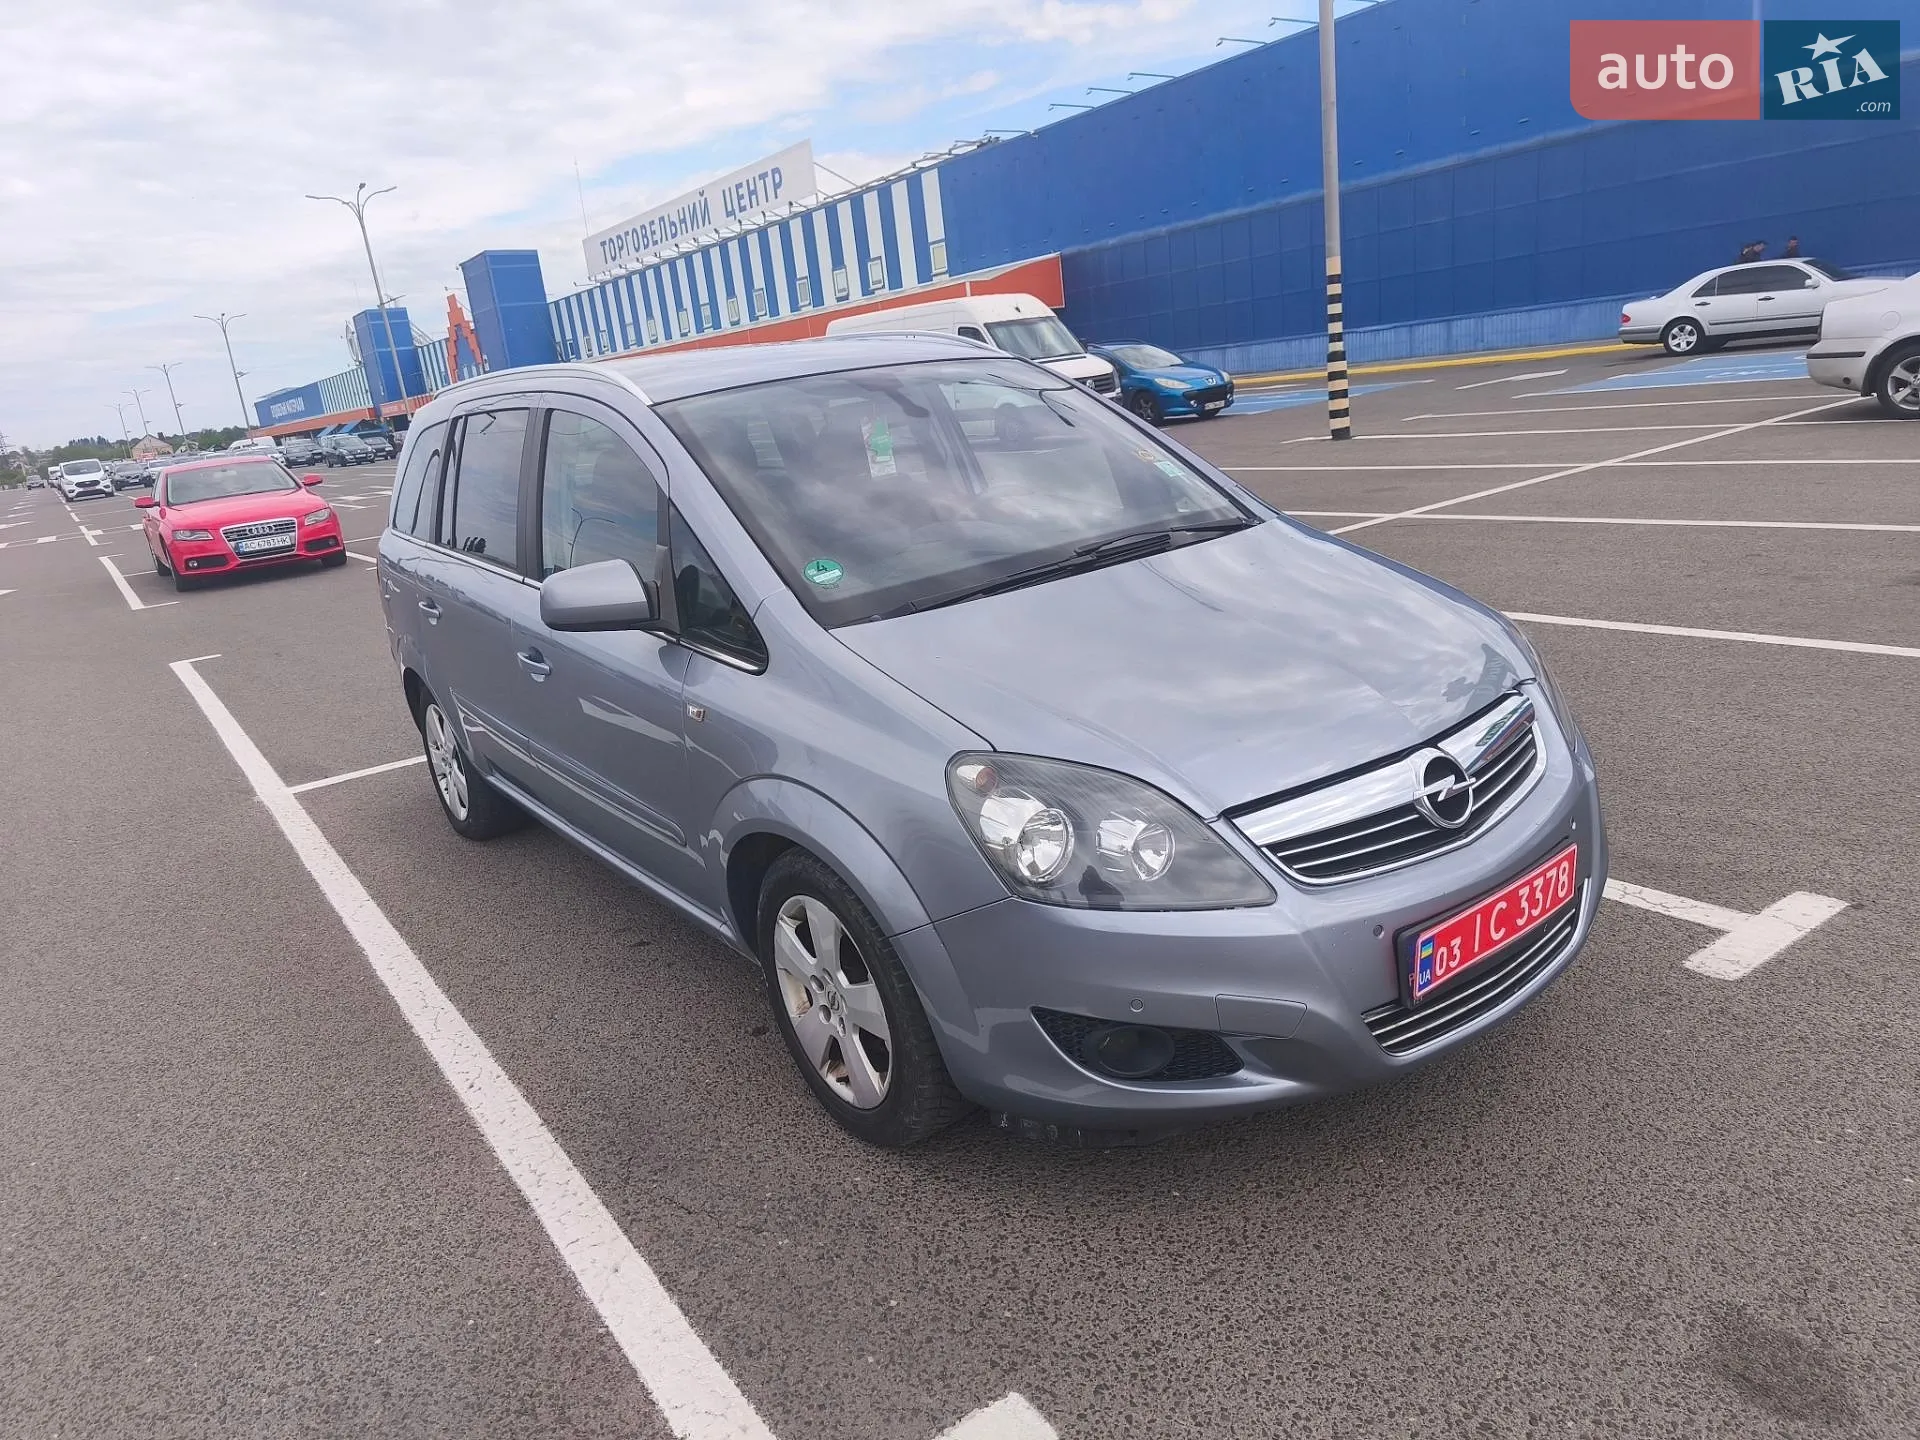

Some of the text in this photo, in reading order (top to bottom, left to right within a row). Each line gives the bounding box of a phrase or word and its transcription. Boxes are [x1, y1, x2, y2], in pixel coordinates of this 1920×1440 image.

[600, 167, 783, 265] ТОРГОВЕЛЬНИЙ ЦЕНТР
[1435, 937, 1461, 976] 03
[1516, 861, 1569, 927] 3378
[1419, 969, 1431, 985] UA
